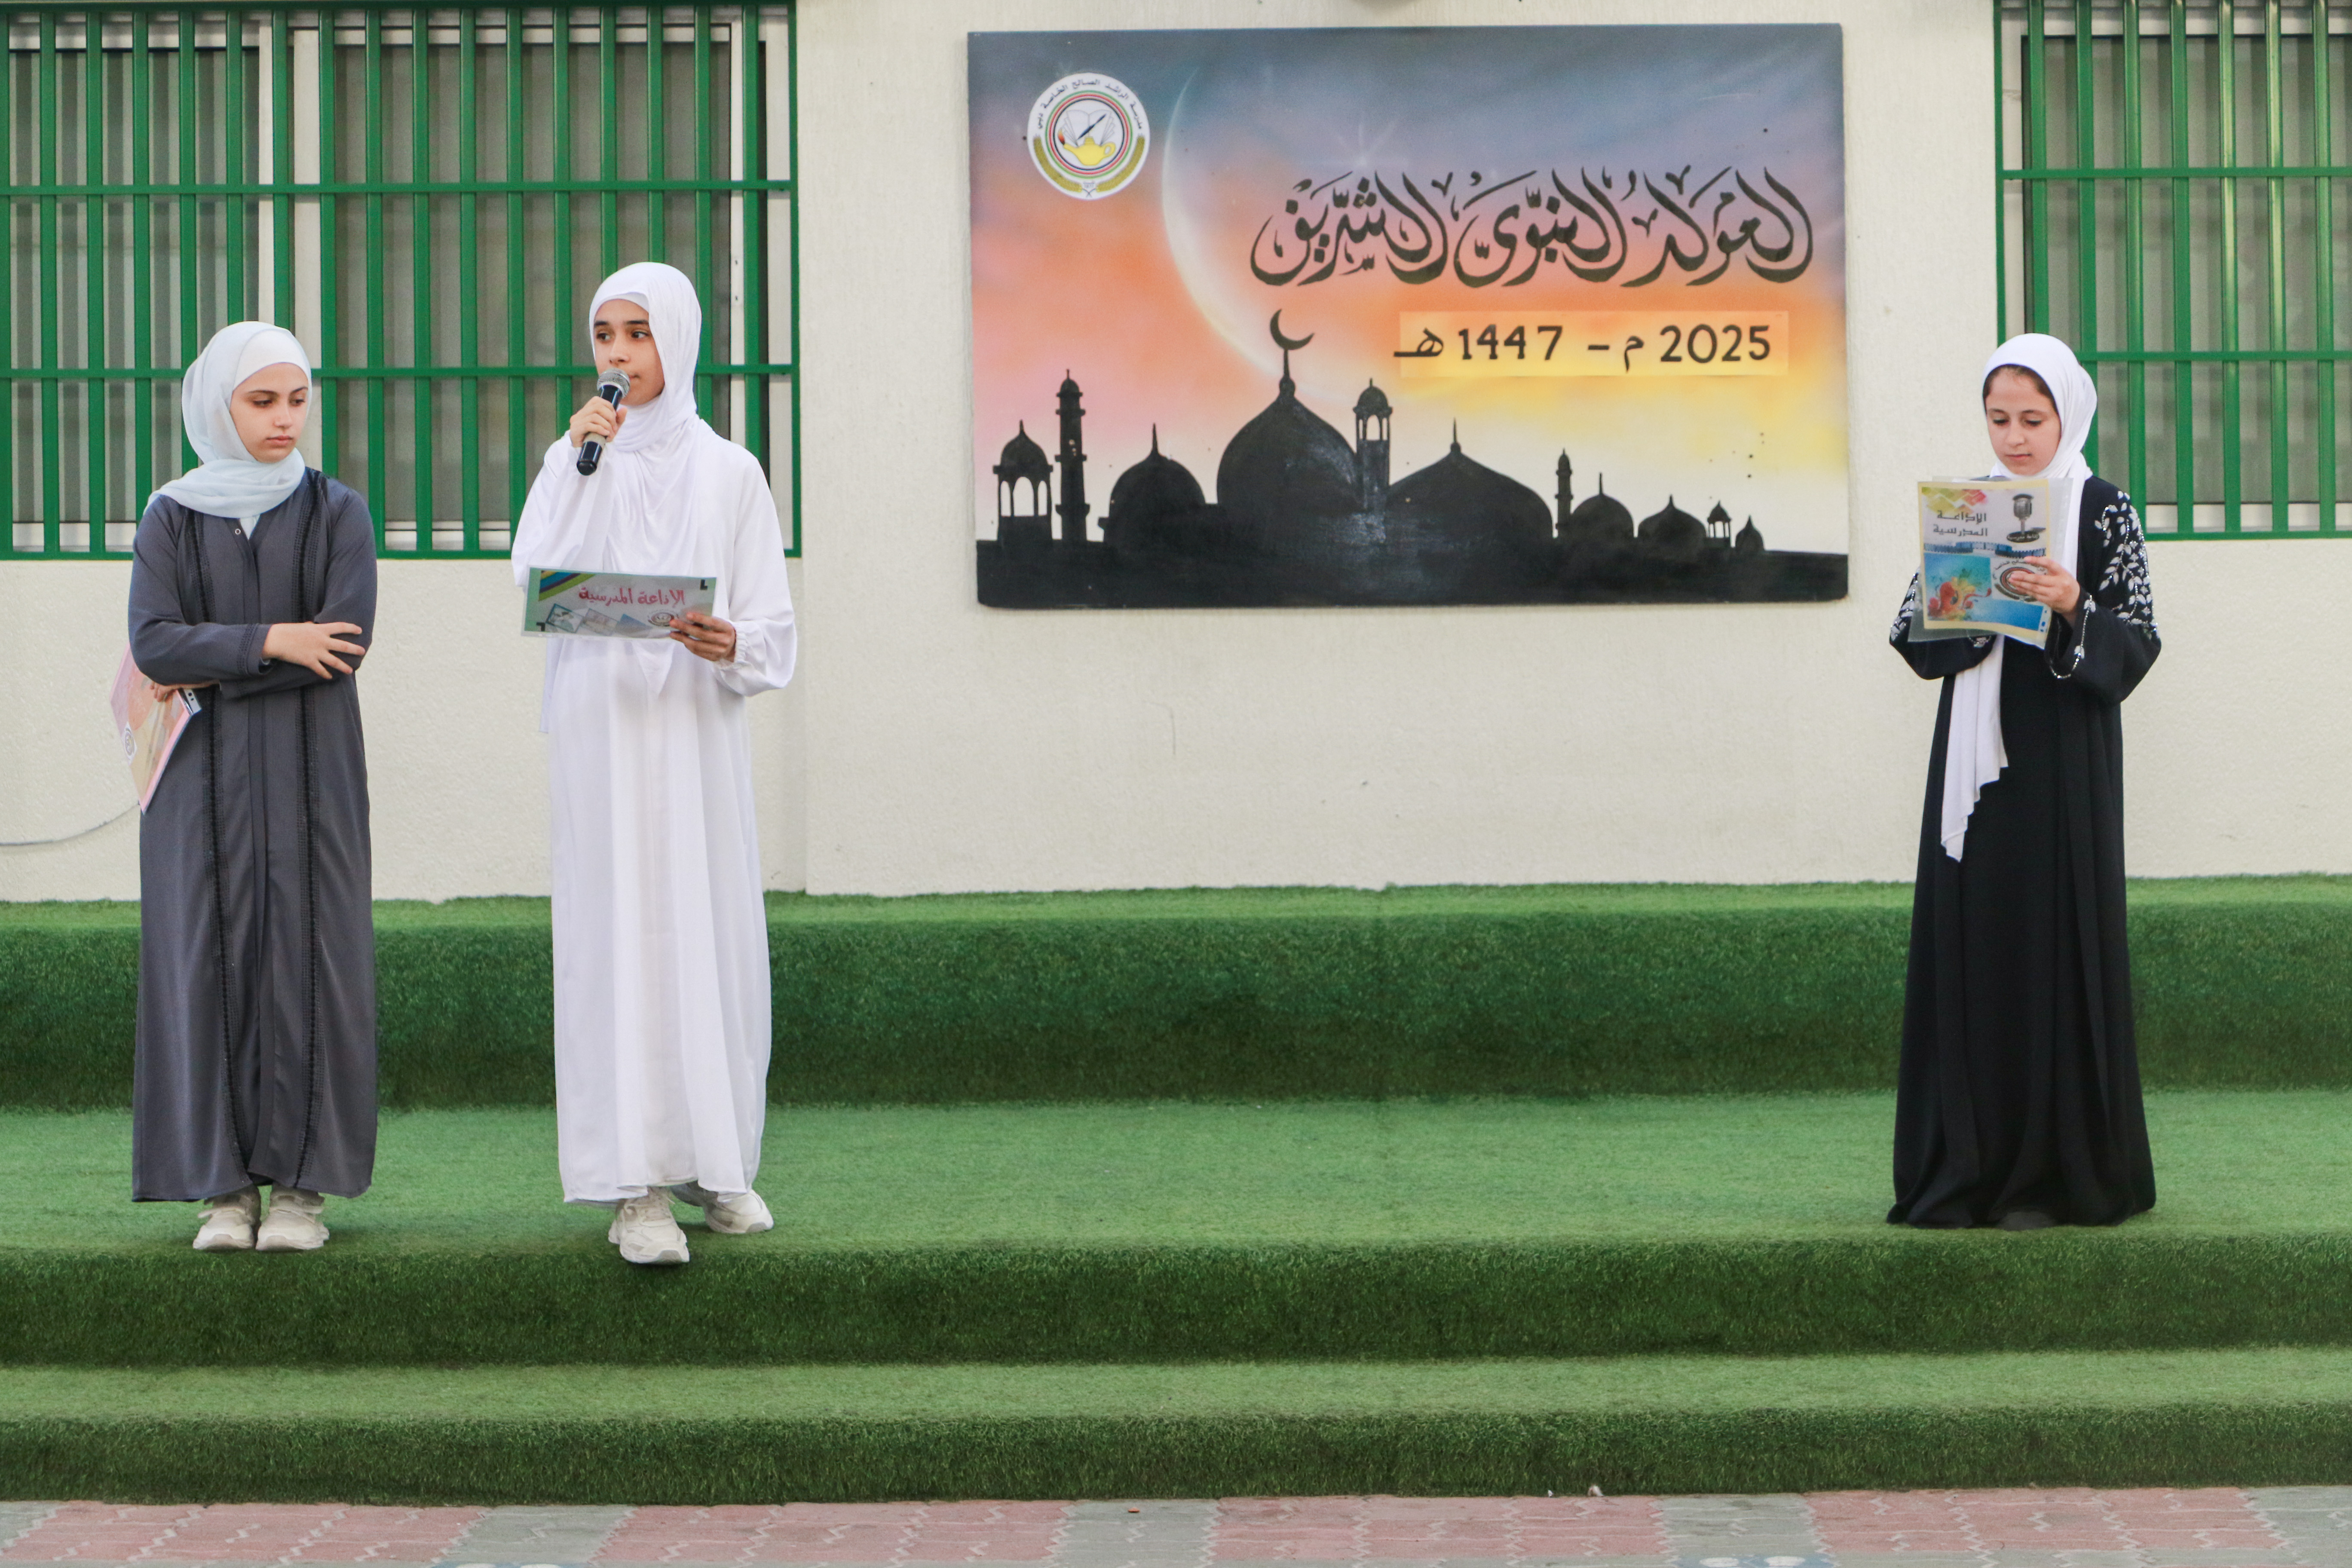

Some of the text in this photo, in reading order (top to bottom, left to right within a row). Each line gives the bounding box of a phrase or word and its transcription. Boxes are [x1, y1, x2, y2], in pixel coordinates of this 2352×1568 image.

[1458, 324, 1563, 360] 1447
[1623, 335, 1645, 373] م
[1660, 323, 1770, 364] 2025
[1933, 524, 1988, 536] المدرسية
[579, 587, 633, 606] المدرسية
